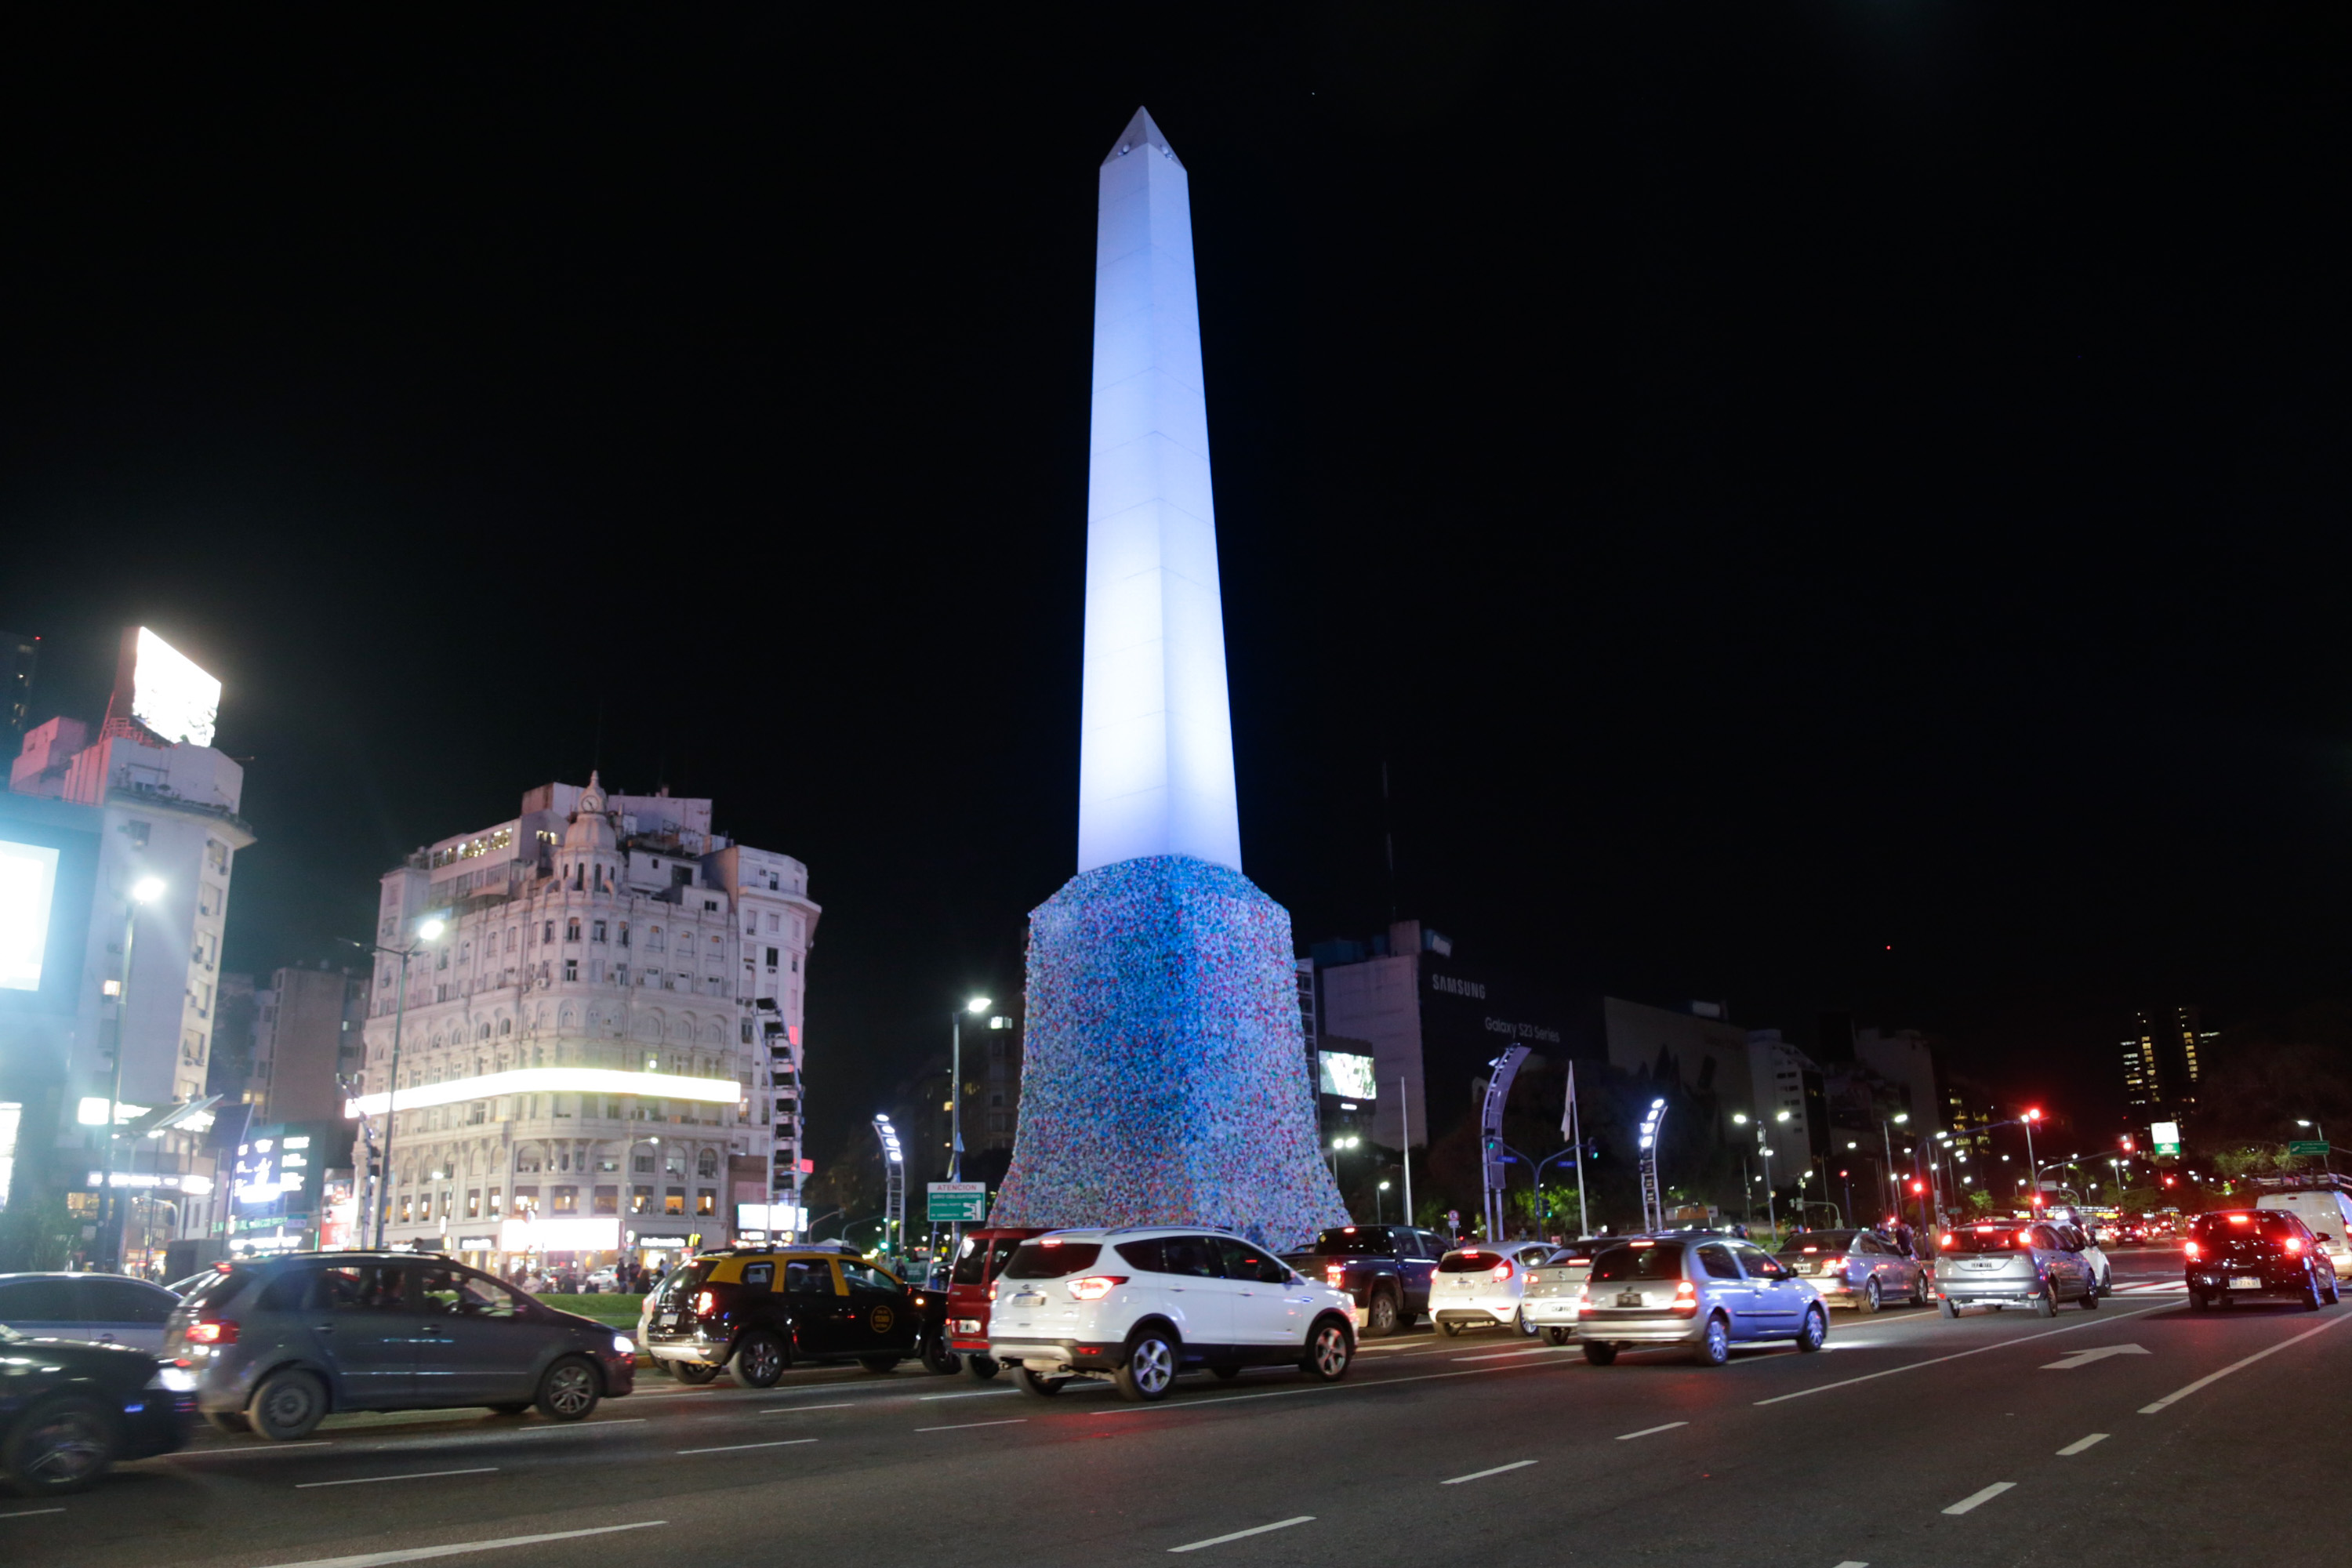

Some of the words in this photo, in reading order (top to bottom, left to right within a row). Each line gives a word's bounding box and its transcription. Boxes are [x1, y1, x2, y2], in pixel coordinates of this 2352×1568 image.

[1432, 973, 1486, 1000] SAMSUNG
[1484, 1016, 1517, 1040] Galaxy
[1518, 1022, 1534, 1039] S23
[1534, 1026, 1560, 1043] Series
